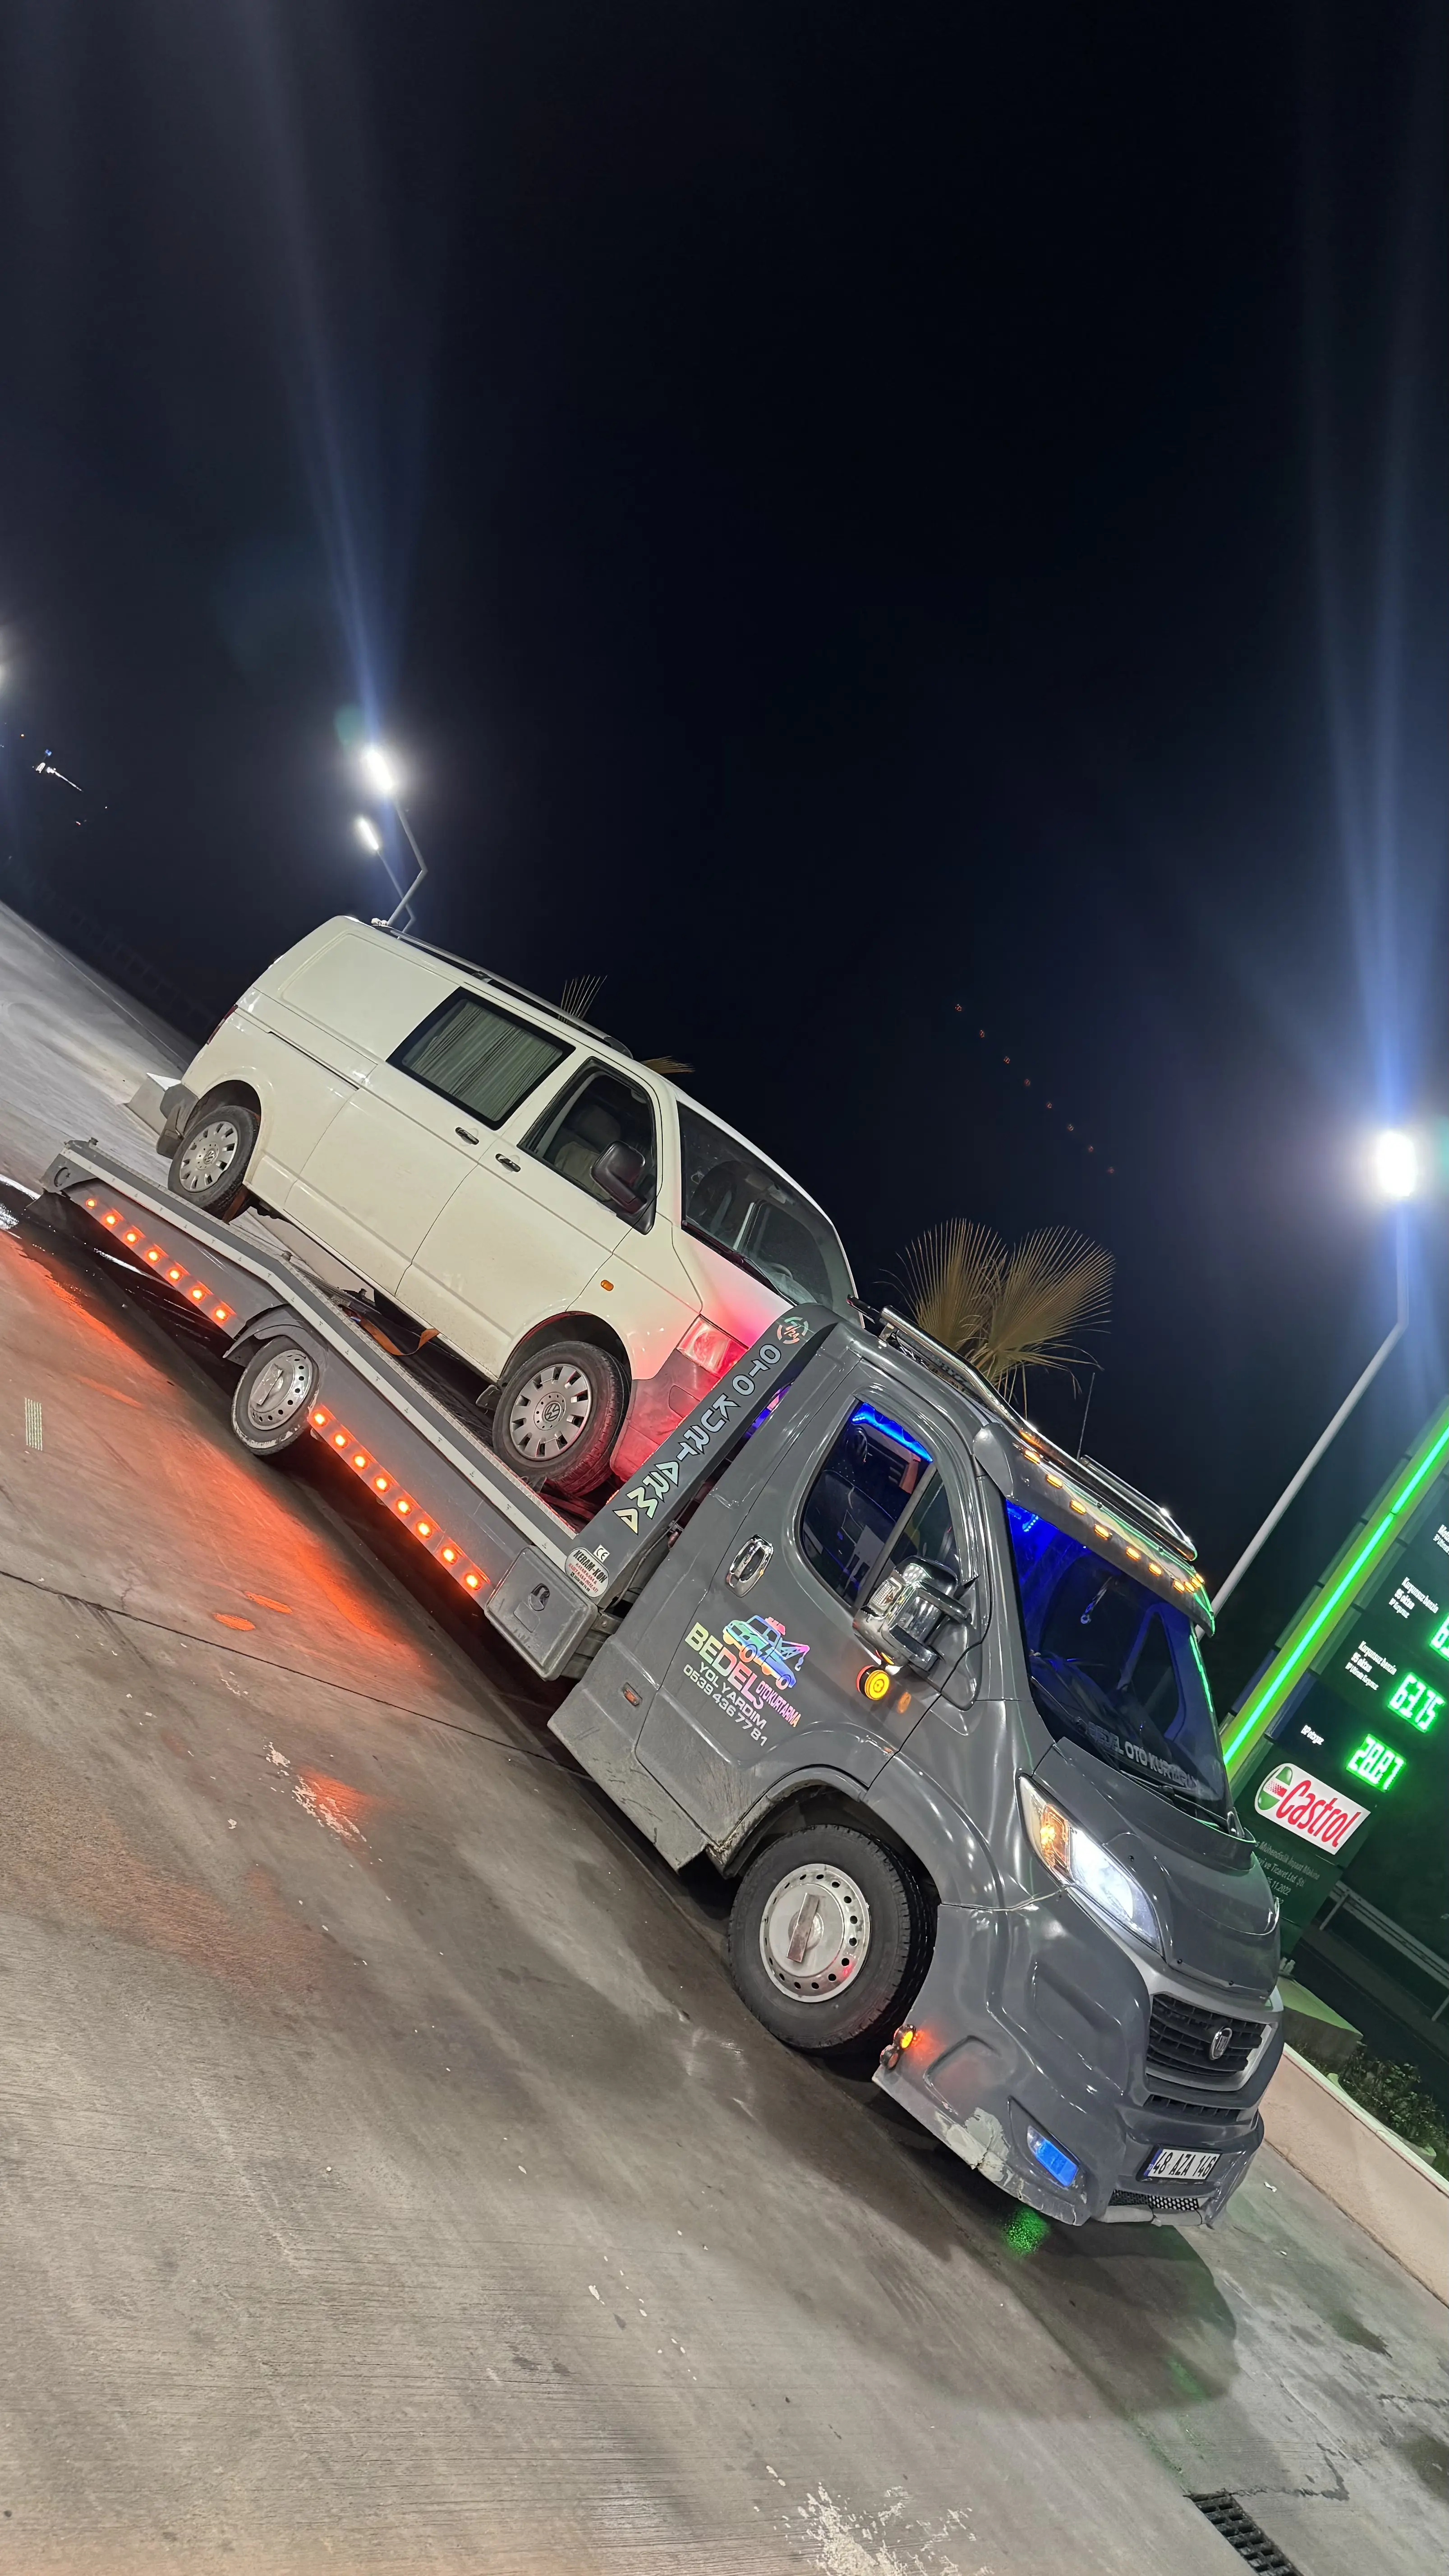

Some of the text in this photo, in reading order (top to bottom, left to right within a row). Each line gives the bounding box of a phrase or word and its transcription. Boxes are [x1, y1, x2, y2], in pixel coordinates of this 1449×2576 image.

[783, 1320, 800, 1339] 7/24
[612, 1344, 782, 1536] OTO KURTARMA
[573, 1550, 607, 1583] KERAM-KON
[596, 1548, 608, 1560] CE
[1394, 1588, 1415, 1610] 95 oktan
[1422, 1595, 1439, 1614] benzin
[1431, 1617, 1449, 1658] 6
[685, 1622, 764, 1709] BEDEL
[1351, 1652, 1372, 1672] 95 oktan
[1380, 1657, 1397, 1675] benzin
[683, 1664, 714, 1695] 0539
[712, 1693, 736, 1717] 436
[699, 1661, 767, 1730] YOL YARDIM
[756, 1681, 801, 1727] OTOKURTARMA
[1301, 1725, 1325, 1745] BP otogaz
[1124, 1741, 1148, 1766] OTO
[1276, 1780, 1362, 1848] Castrol
[1264, 1861, 1271, 1870] ve
[1271, 1863, 1288, 1879] Ticaret
[1153, 2152, 1217, 2177] 48 AZA 146
